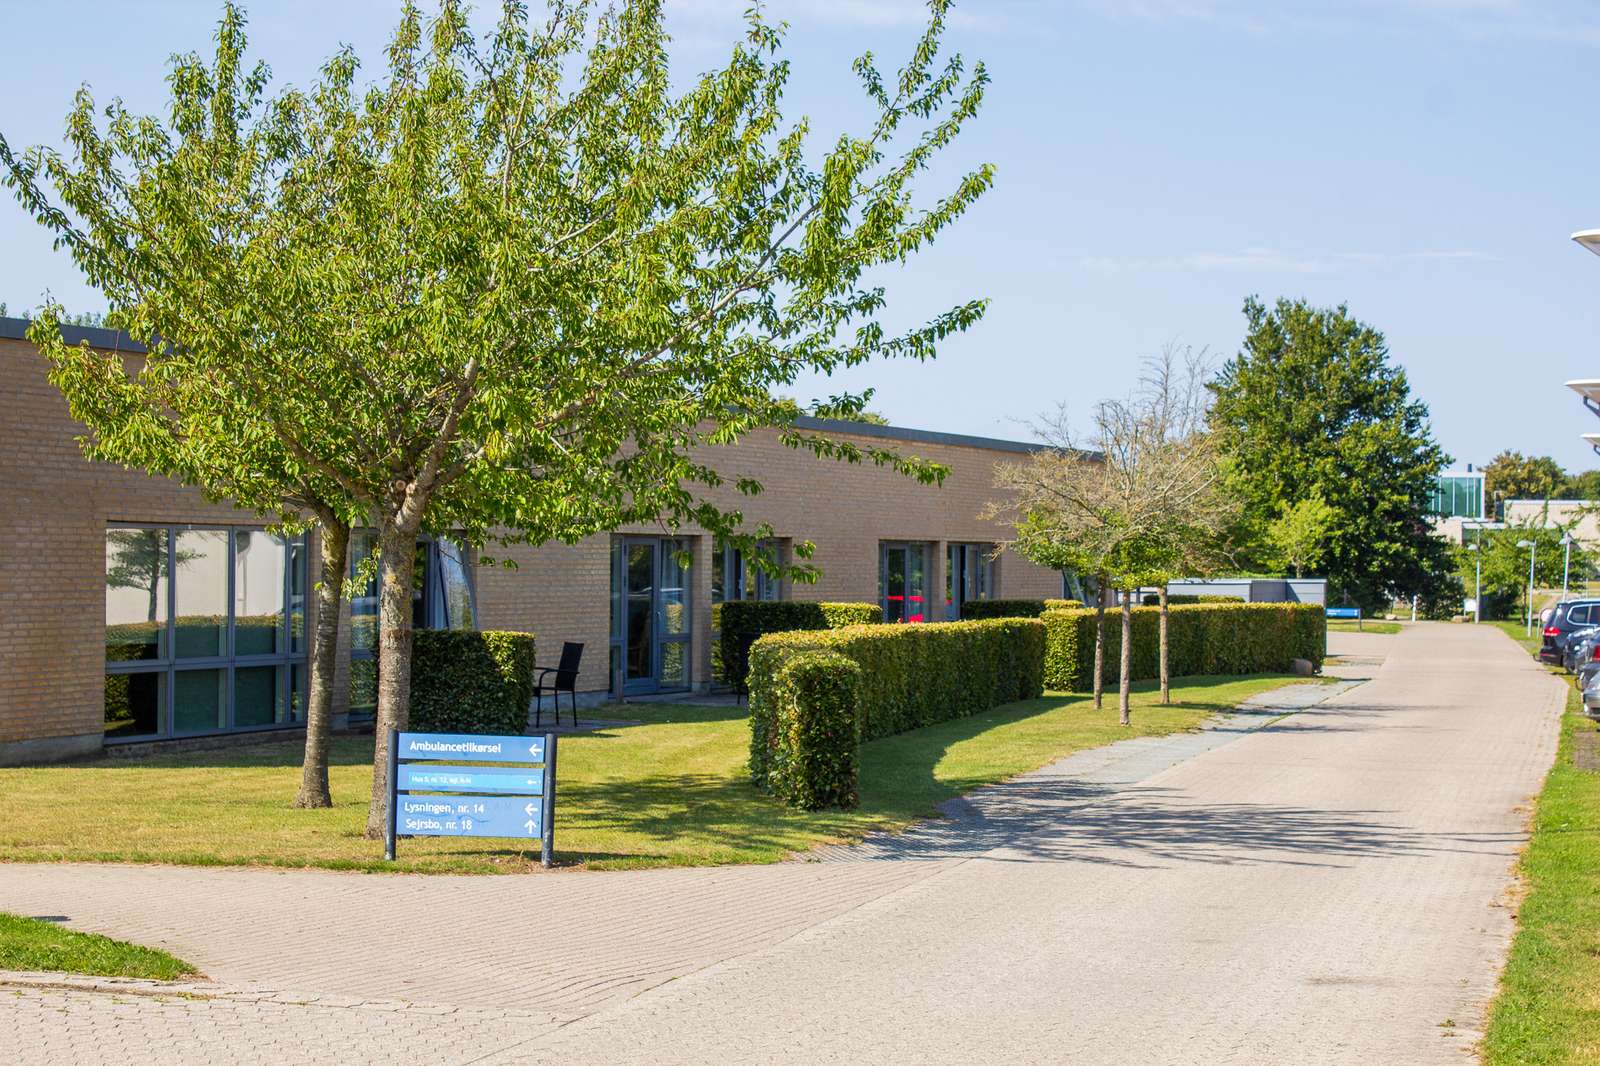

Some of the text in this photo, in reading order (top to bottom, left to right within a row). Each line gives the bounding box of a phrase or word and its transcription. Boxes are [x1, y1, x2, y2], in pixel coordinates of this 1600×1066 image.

[410, 741, 501, 753] Ambulancetilkørsel
[404, 802, 454, 815] Lysningen,
[474, 804, 484, 814] 14
[461, 819, 472, 830] 18
